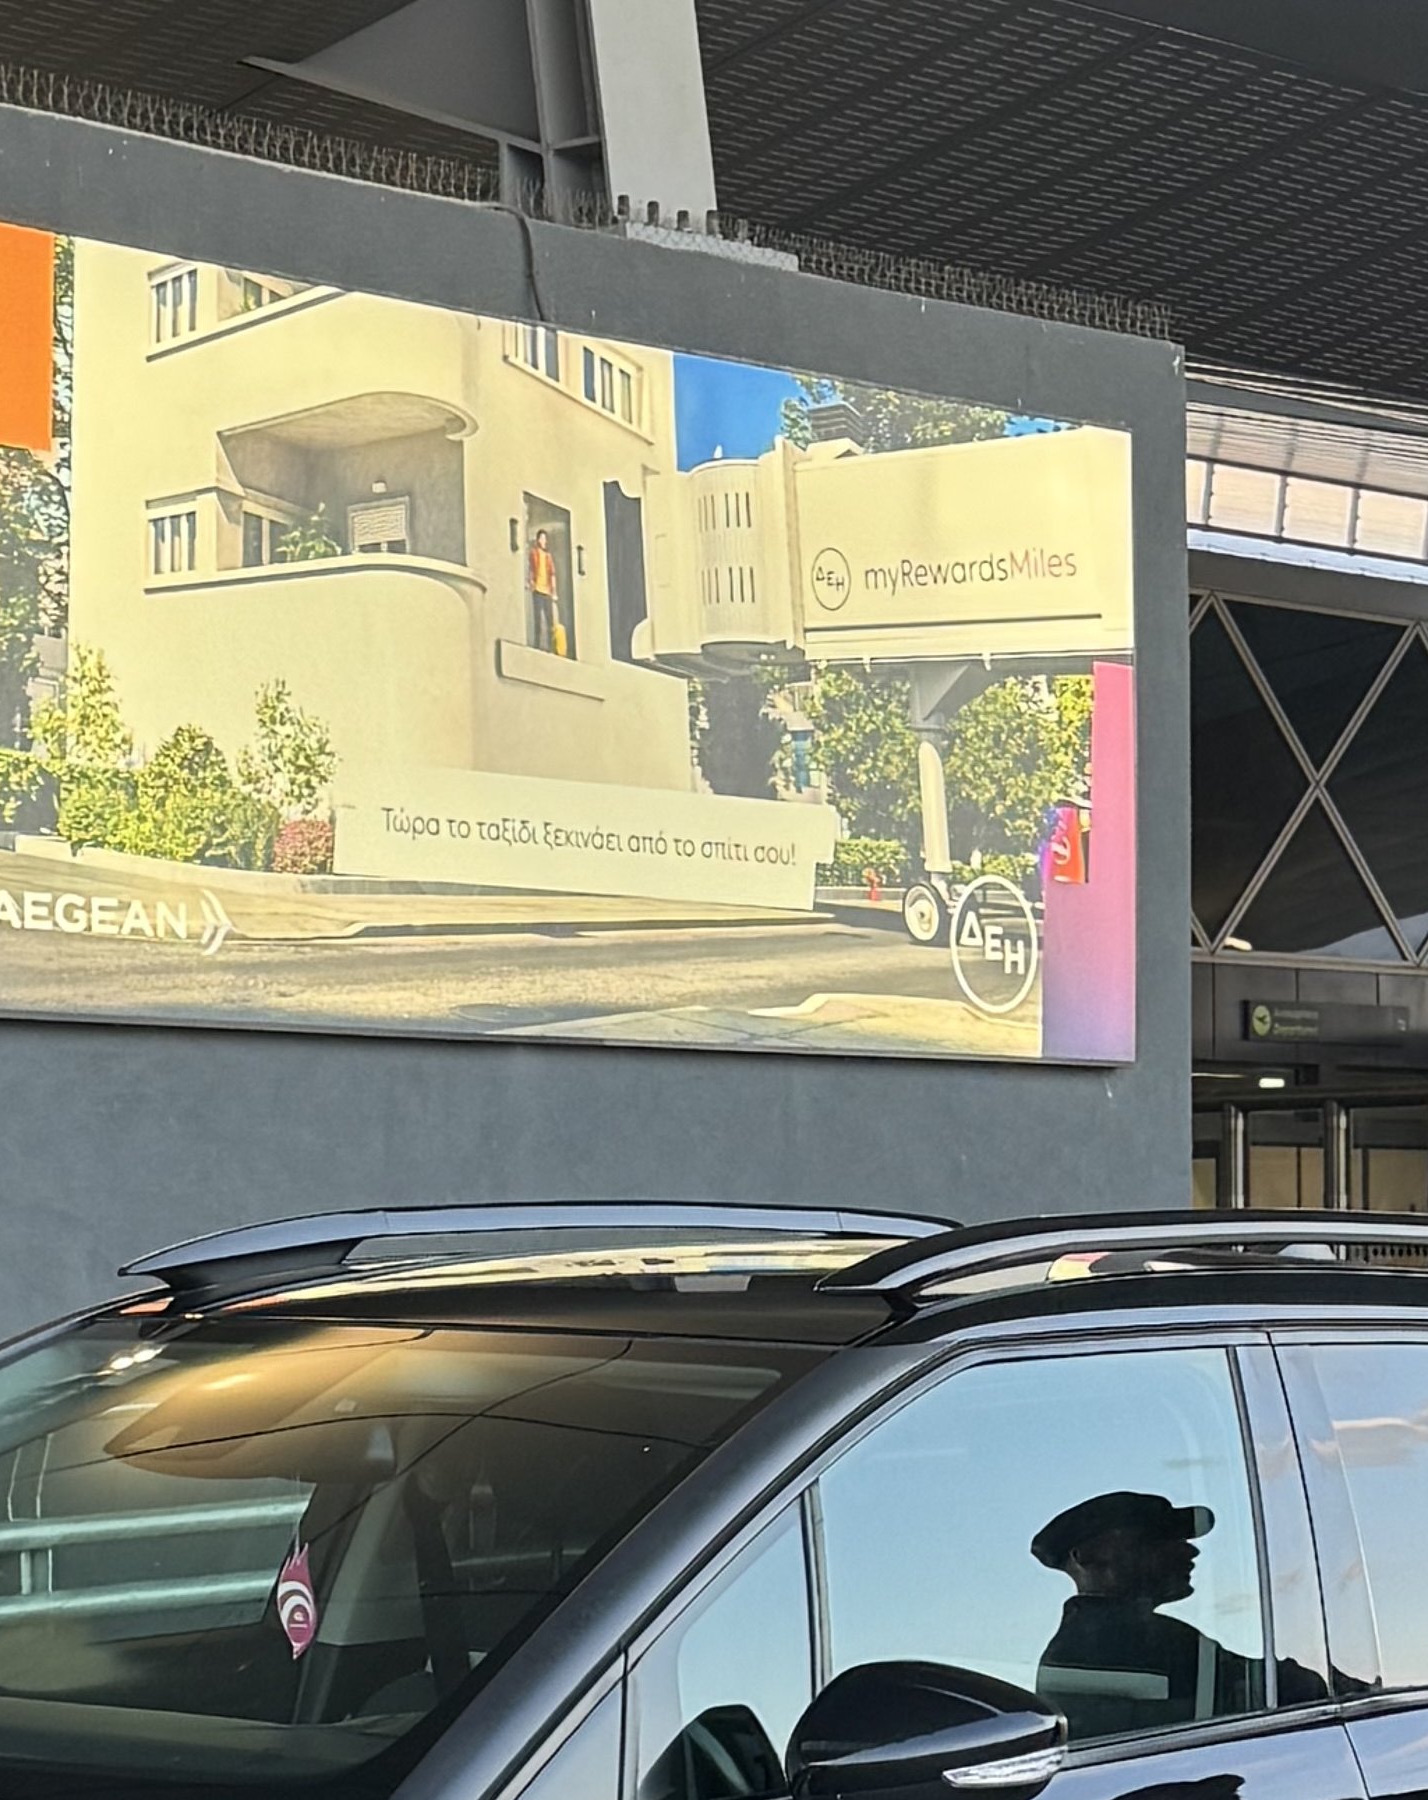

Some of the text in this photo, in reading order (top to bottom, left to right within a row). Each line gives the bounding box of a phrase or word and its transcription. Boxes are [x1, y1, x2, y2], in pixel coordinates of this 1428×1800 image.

[864, 548, 1078, 597] myRewardsMiles
[381, 807, 797, 867] Τώρα το ταξίδι ξεκινάει από το σπίτι σου!
